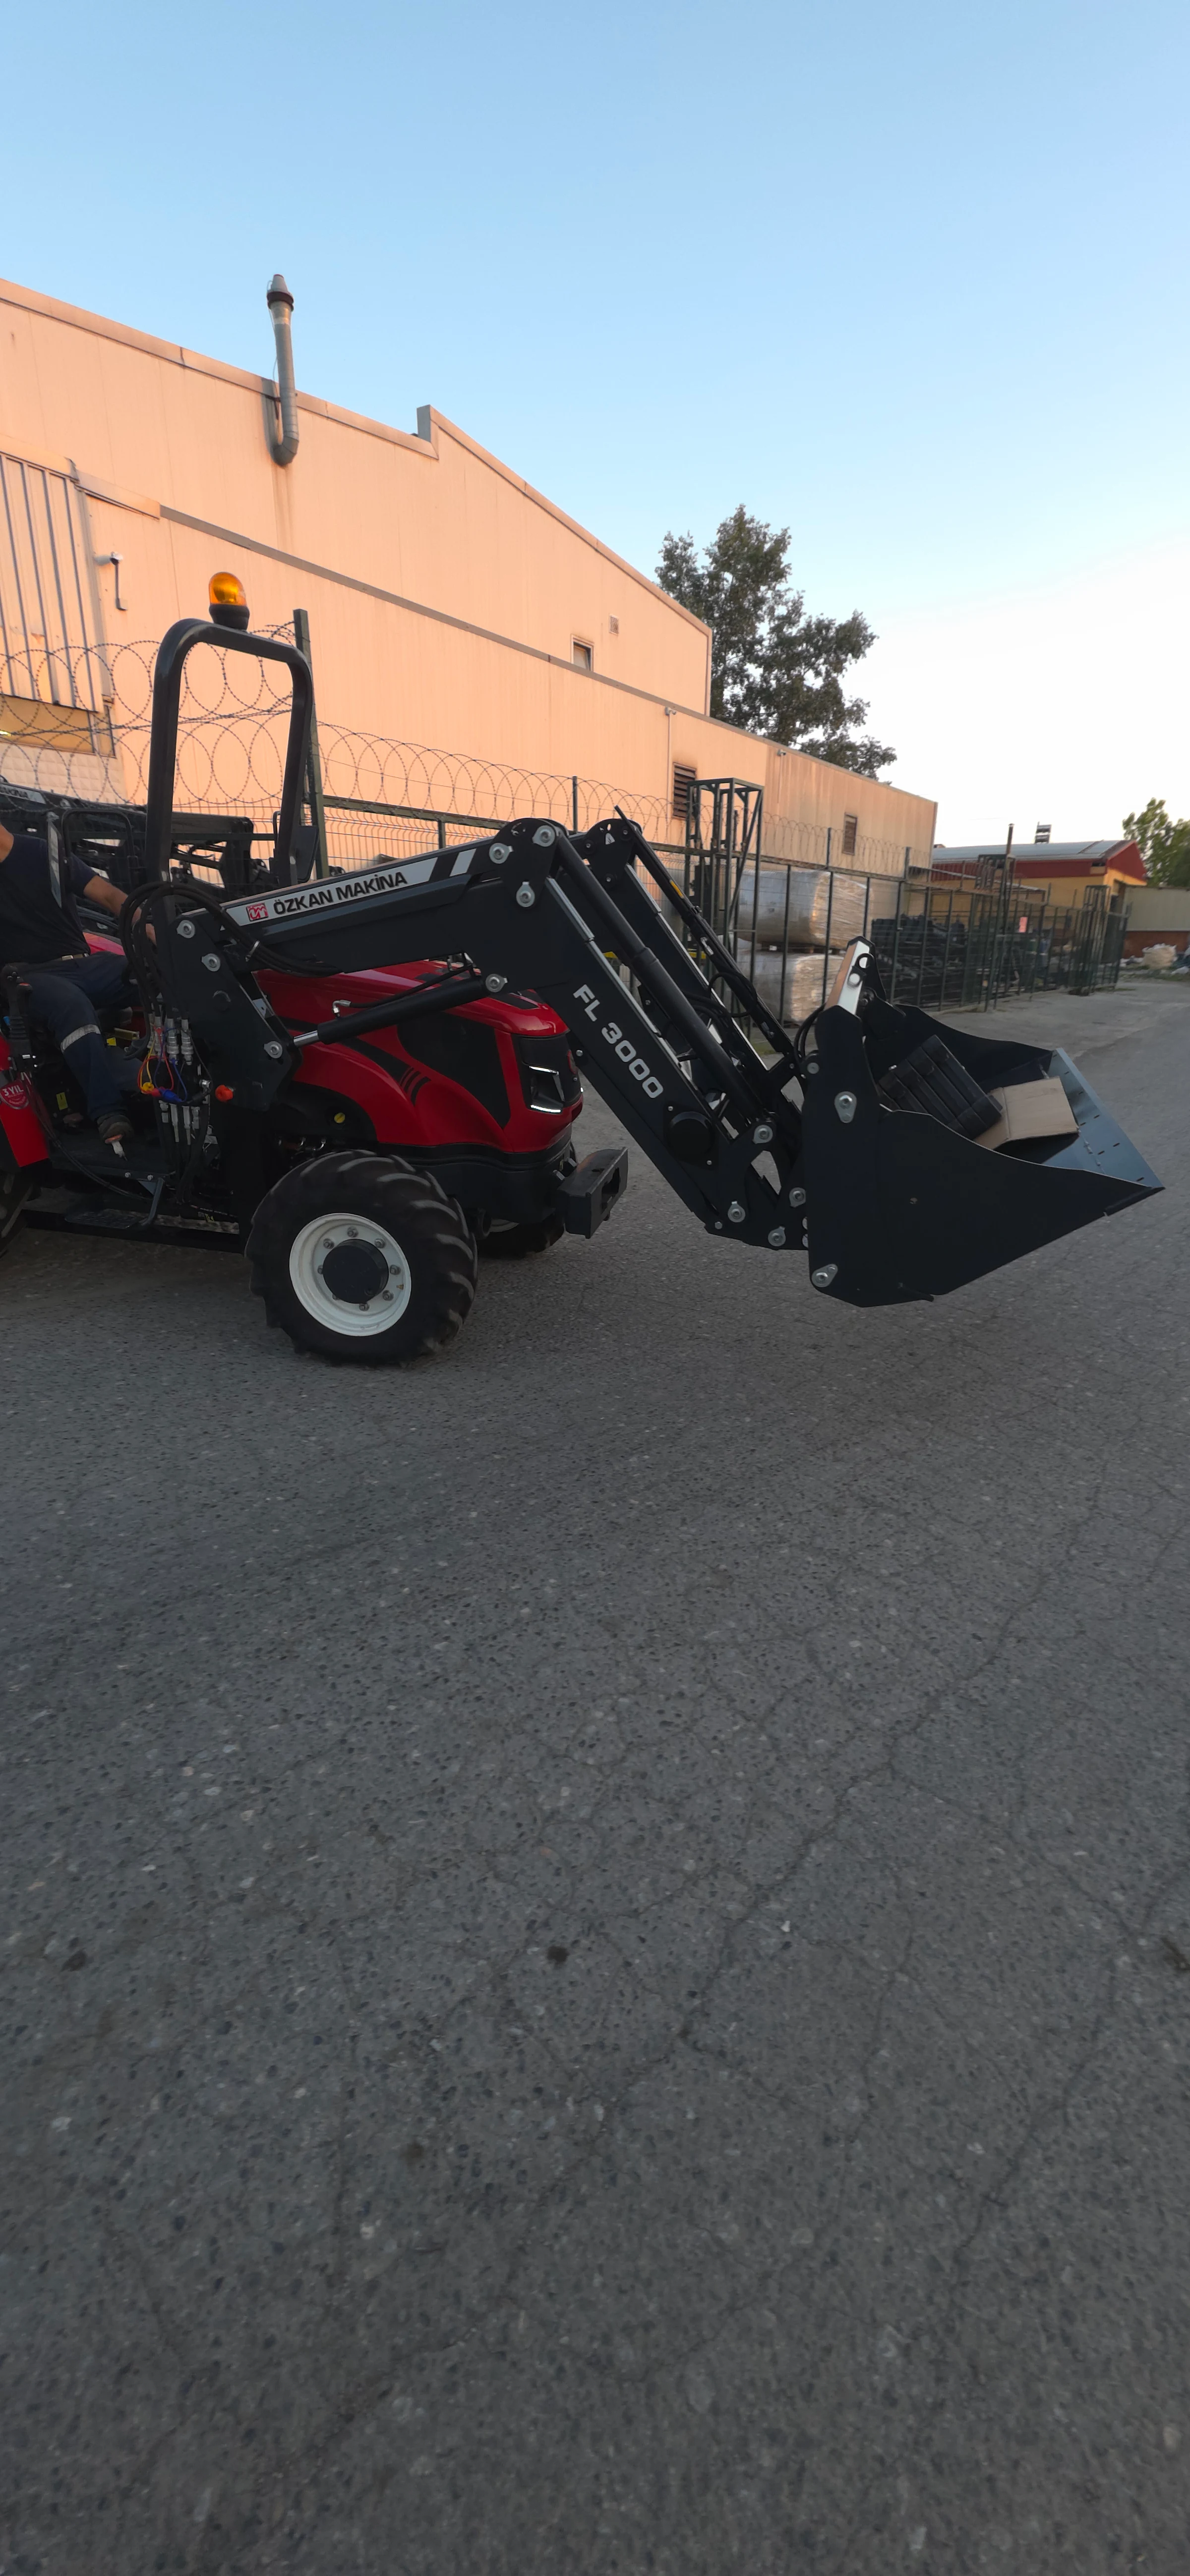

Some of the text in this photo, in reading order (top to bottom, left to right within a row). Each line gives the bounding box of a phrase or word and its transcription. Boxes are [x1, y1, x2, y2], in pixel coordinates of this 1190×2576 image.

[273, 889, 334, 915] ÖZKAN
[336, 871, 408, 901] MAKİNA
[573, 984, 664, 1098] FL 3000
[2, 1085, 24, 1096] 3 YIL
